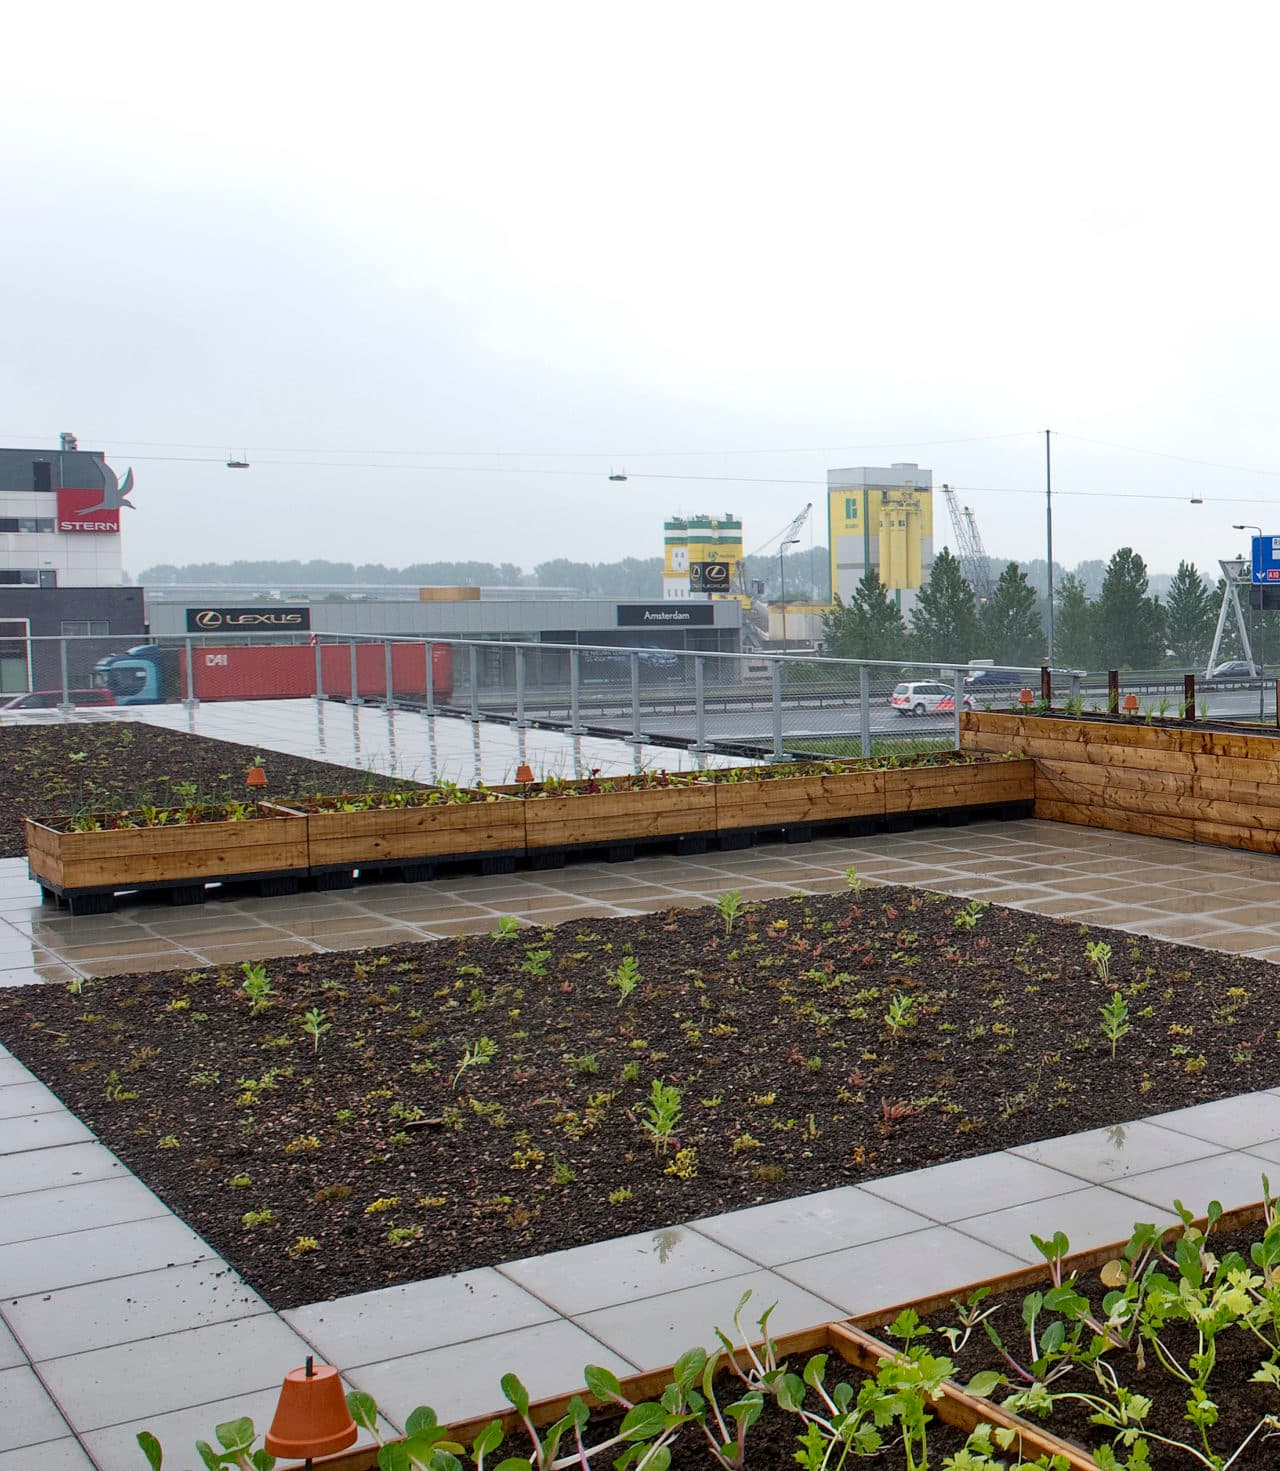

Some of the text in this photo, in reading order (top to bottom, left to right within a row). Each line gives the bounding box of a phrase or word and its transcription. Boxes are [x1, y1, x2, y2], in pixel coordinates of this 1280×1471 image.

[60, 521, 118, 531] STERN
[226, 614, 302, 624] LEXUS
[643, 610, 690, 620] Amsterdam
